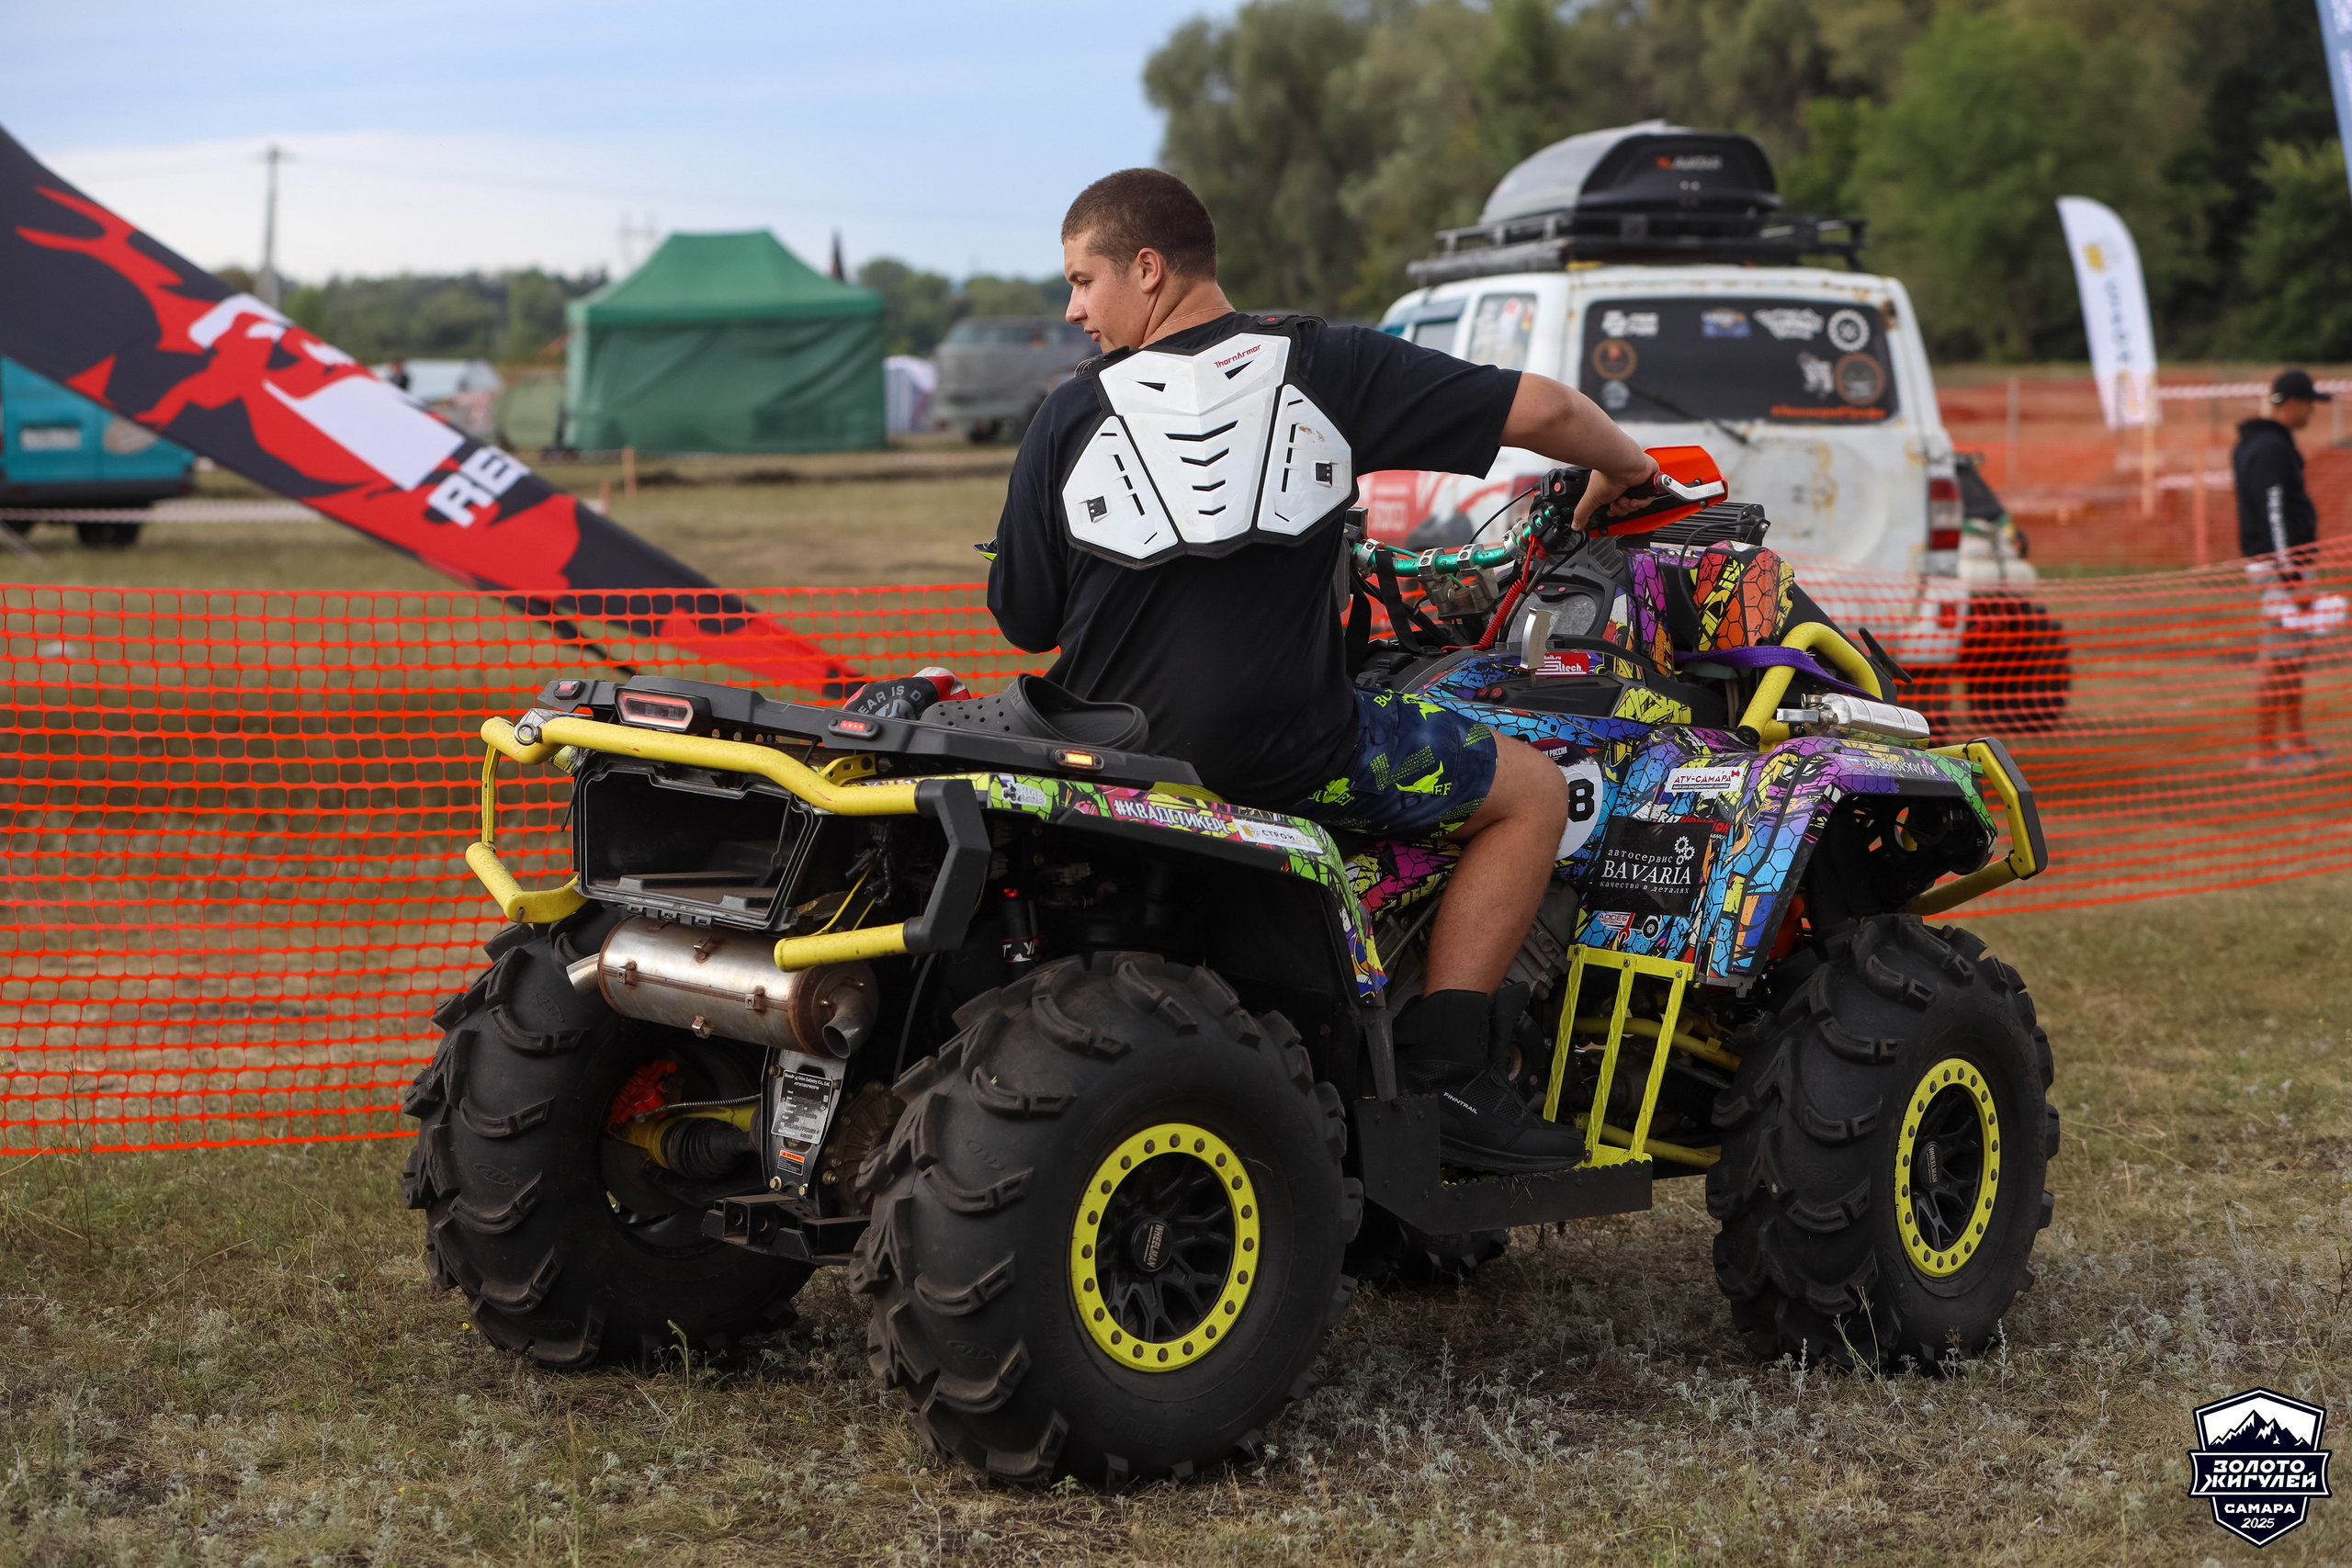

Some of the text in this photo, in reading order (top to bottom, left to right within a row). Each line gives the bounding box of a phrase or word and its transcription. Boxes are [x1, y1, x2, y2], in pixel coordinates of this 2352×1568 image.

[1214, 344, 1261, 368] ThornArmor
[891, 684, 905, 697] IS
[1549, 746, 1568, 758] РОССИИ
[1113, 798, 1232, 835] #КВАДСТИКЕРС
[1607, 849, 1674, 864] автосервис
[1601, 860, 1692, 885] BAVARIA
[1600, 880, 1640, 890] качество
[1650, 885, 1690, 895] деталях
[1442, 1091, 1478, 1115] FINNTRAIL
[1928, 1146, 1939, 1183] WHEELMAN
[1147, 1224, 1165, 1269] WHEELMAN
